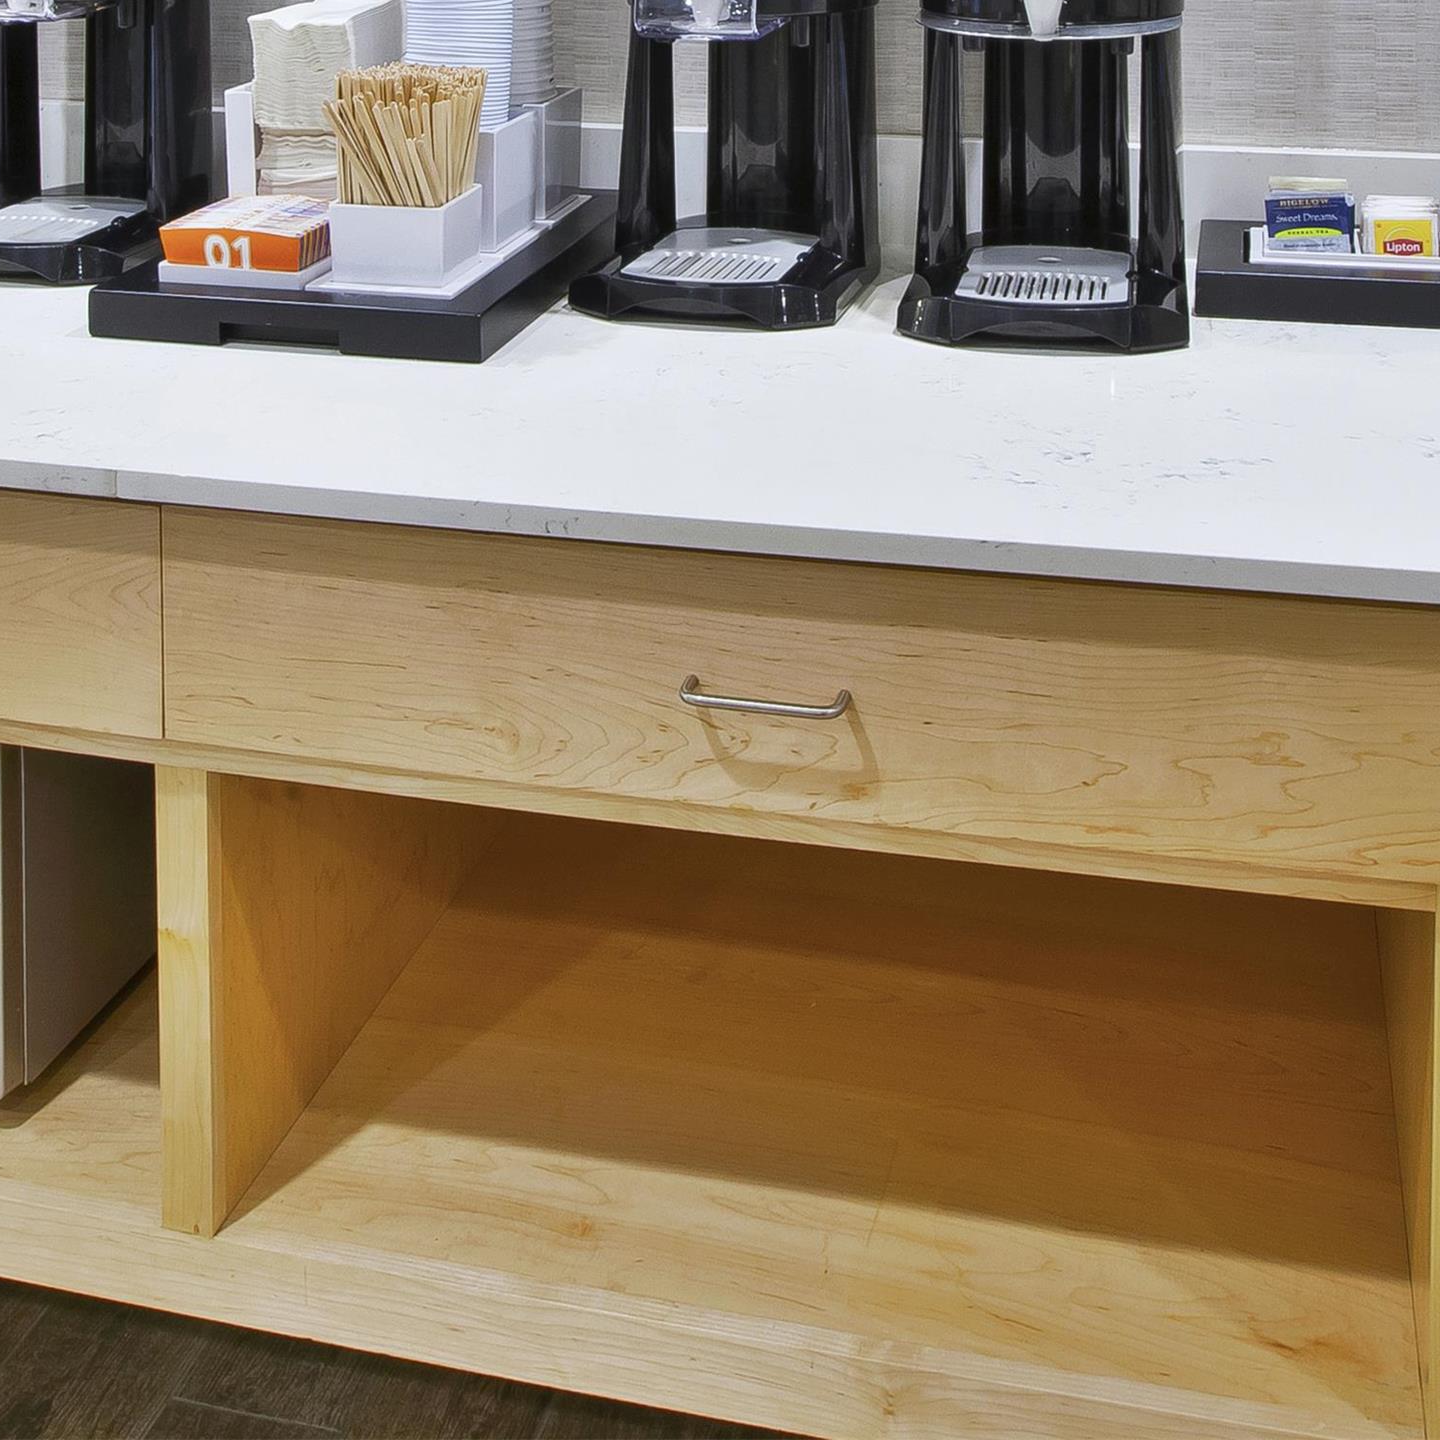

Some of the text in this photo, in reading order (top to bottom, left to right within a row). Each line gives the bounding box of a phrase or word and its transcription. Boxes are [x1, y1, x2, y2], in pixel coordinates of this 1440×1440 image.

[1280, 198, 1329, 207] BIGELOW
[1276, 214, 1302, 223] Sweet
[204, 234, 251, 271] 01
[1386, 242, 1421, 254] Lipton
